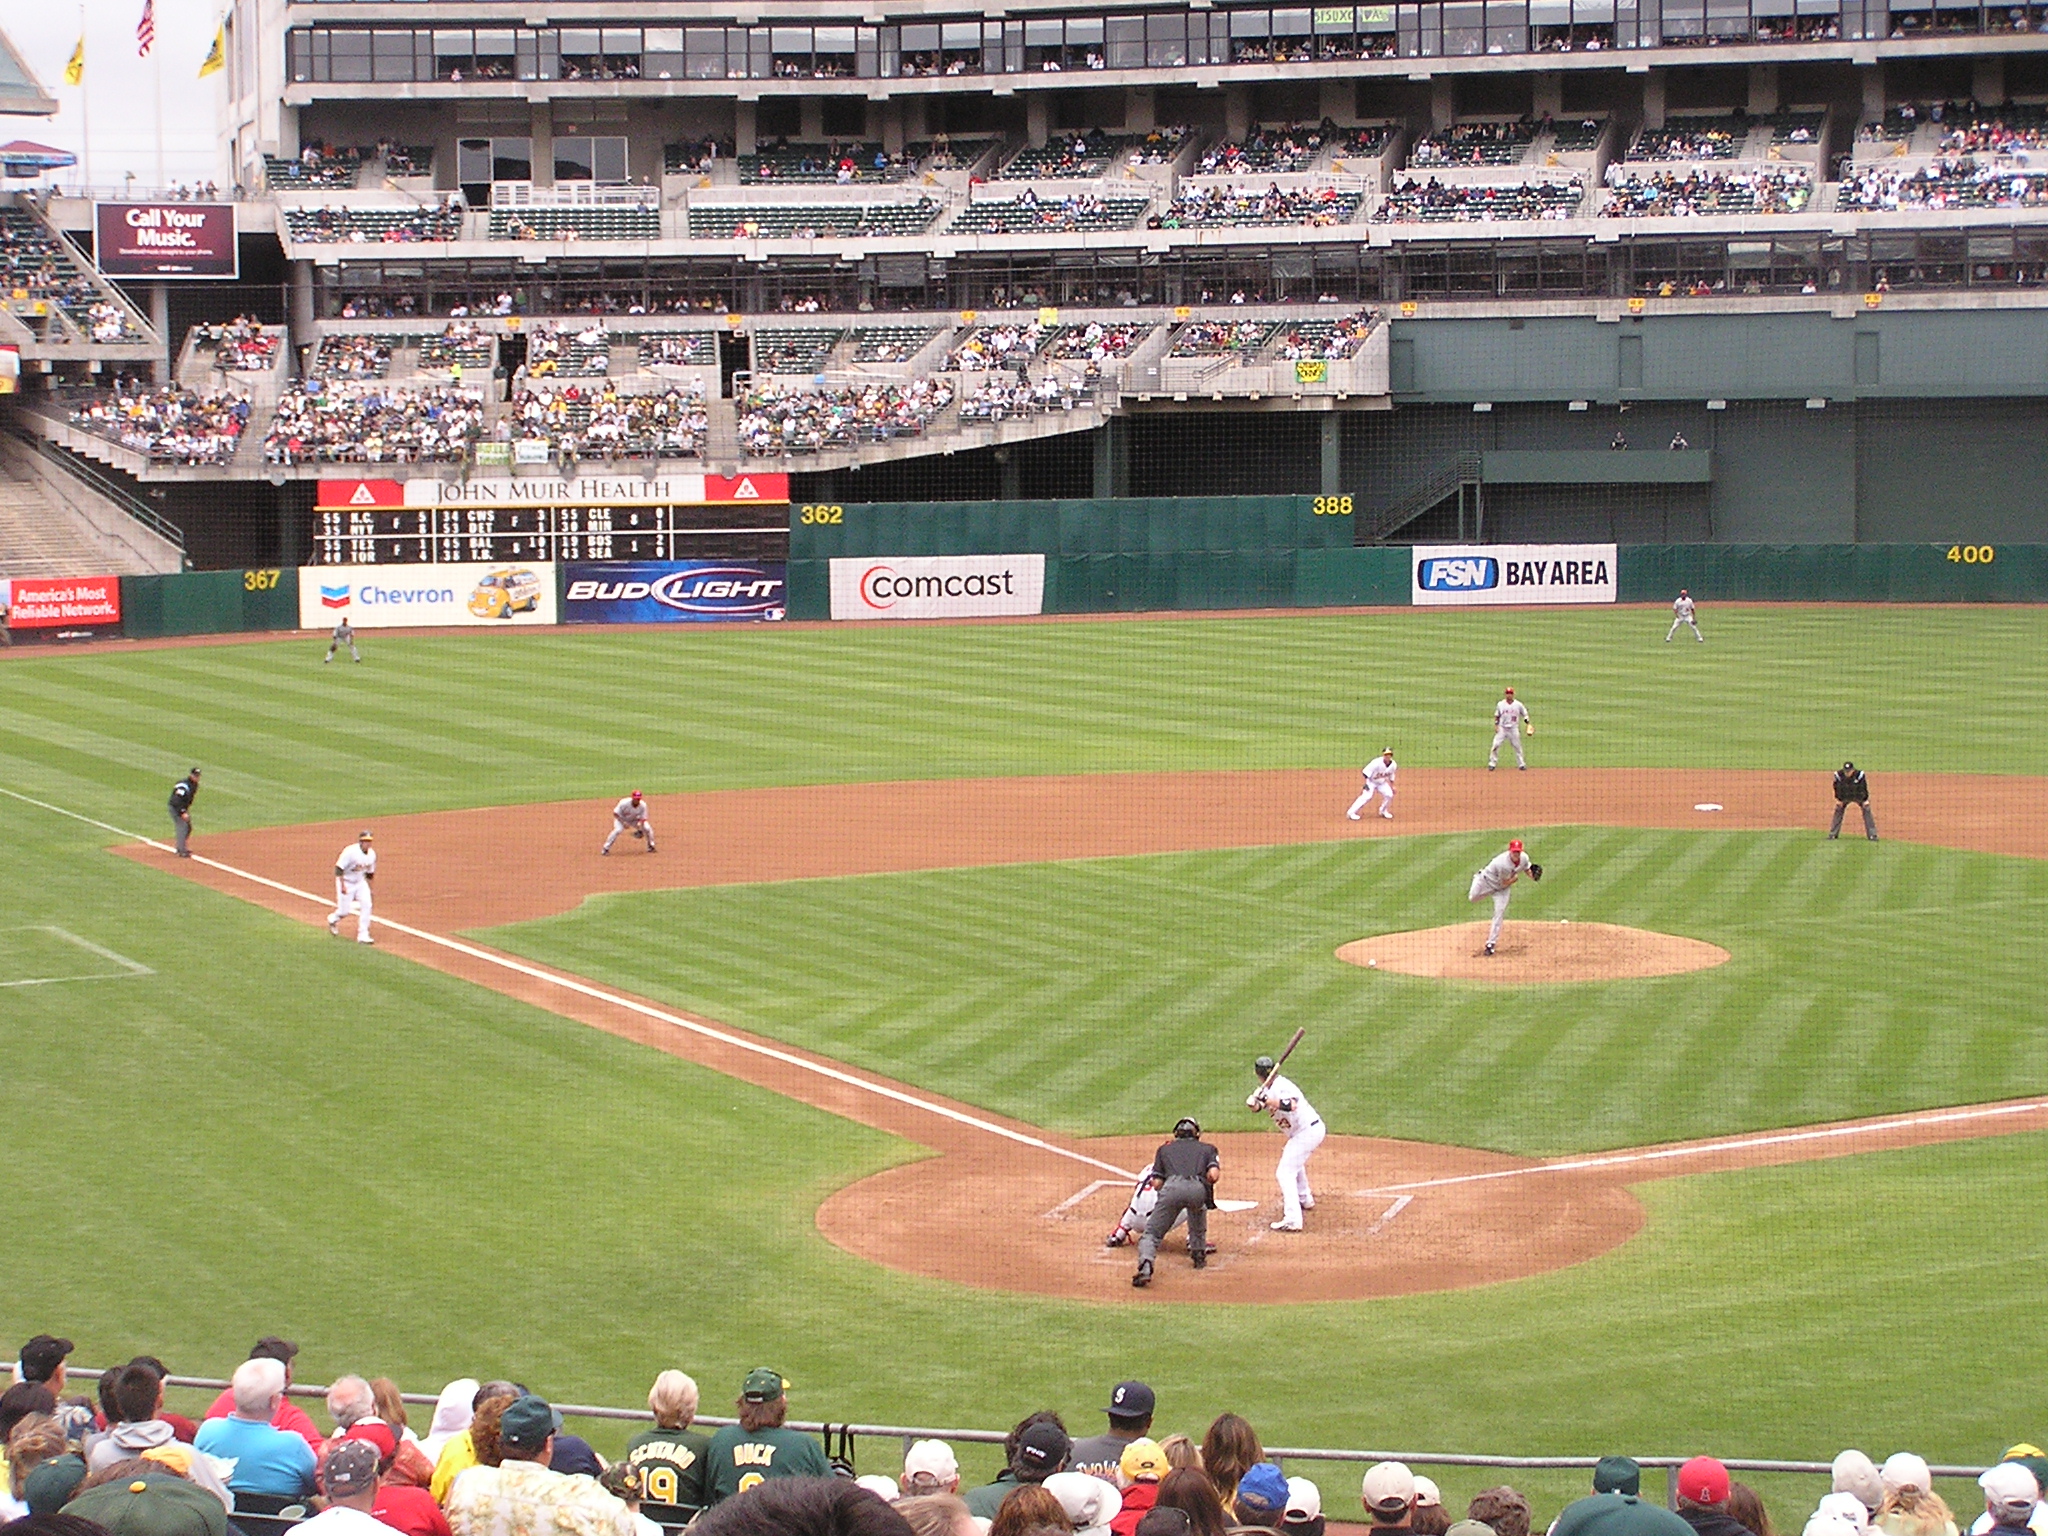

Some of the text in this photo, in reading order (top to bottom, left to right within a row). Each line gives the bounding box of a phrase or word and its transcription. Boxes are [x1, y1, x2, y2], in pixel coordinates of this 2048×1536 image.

[125, 208, 206, 228] Call Your
[136, 228, 197, 247] Music.
[436, 480, 670, 505] JOHN MUIR HEALTH
[561, 508, 578, 520] 55
[588, 507, 611, 520] CLE
[1312, 496, 1353, 515] 388
[323, 512, 340, 524] 55
[443, 509, 545, 522] 34 CWS 3
[511, 515, 518, 527] F
[800, 505, 843, 525] 362
[323, 524, 340, 536] 35
[443, 522, 459, 534] 53
[469, 522, 493, 534] DET
[561, 519, 662, 532] 30 MIN 1
[324, 538, 426, 551] 55 TEX 1
[469, 537, 493, 549] BAL
[562, 534, 664, 547] 19 BOS 2
[631, 540, 638, 552] 1
[324, 550, 427, 563] 40 TOR 4
[393, 543, 400, 556] F
[537, 548, 545, 559] 3
[562, 548, 578, 559] 43
[588, 547, 612, 559] SEA
[1946, 544, 1994, 563] 400
[244, 568, 281, 591] 367
[1429, 559, 1609, 587] FSN BAY AREA
[566, 580, 783, 600] BUD LIGHT
[871, 569, 1014, 599] comcast
[18, 587, 106, 603] America's Most
[359, 585, 454, 605] Chevron
[12, 601, 116, 619] Reliable Network.
[1114, 1387, 1126, 1404] S
[639, 1466, 678, 1505] 19
[1700, 1486, 1710, 1502] A
